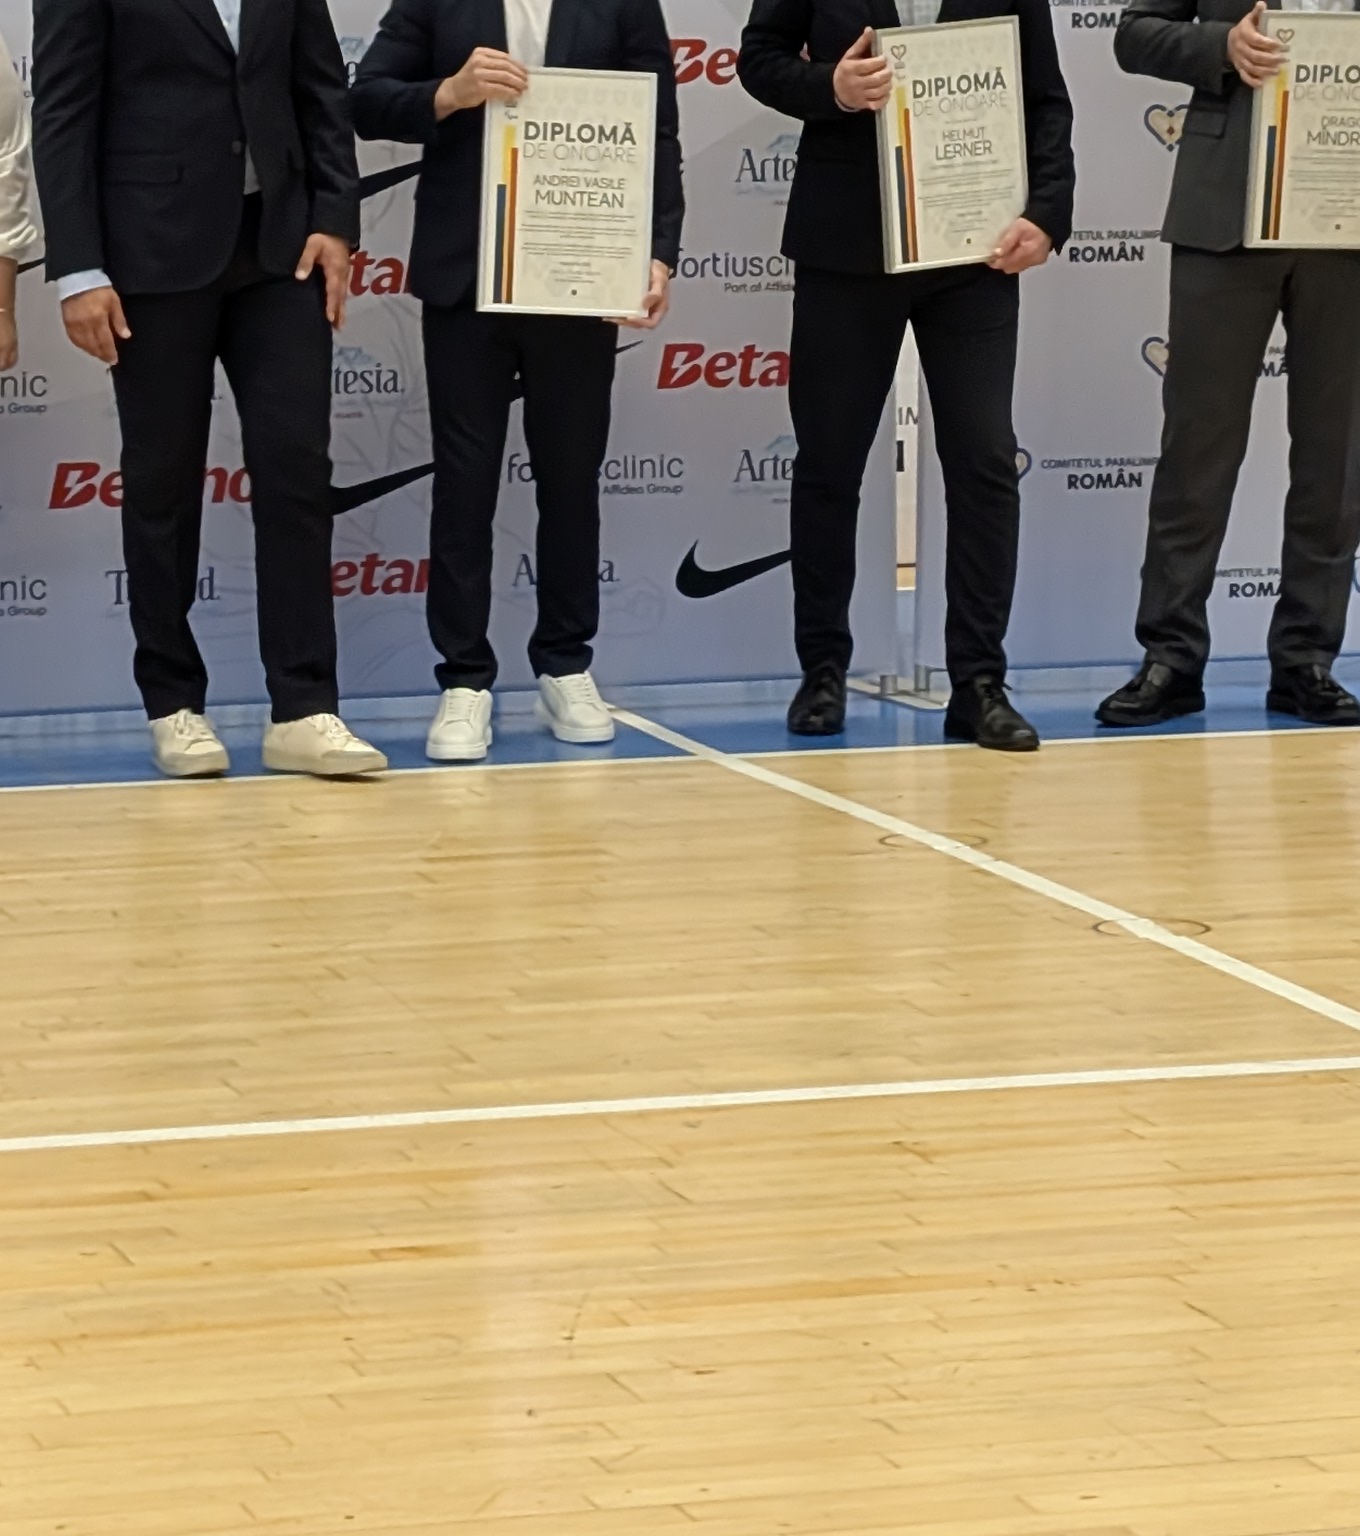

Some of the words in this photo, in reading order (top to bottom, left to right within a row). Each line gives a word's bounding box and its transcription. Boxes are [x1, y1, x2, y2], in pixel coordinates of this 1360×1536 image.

[1071, 13, 1118, 28] ROM
[912, 67, 1007, 99] DIPLOMĂ
[1293, 85, 1317, 101] DE
[913, 100, 933, 117] DE
[938, 91, 1008, 113] ONOARE
[524, 121, 636, 145] DIPLOMĂ
[942, 126, 986, 142] HELMUT
[523, 142, 547, 159] DE
[553, 144, 637, 163] ONOARE
[935, 140, 993, 161] LERNER
[735, 147, 796, 183] Arte
[584, 177, 626, 190] VASILE
[535, 190, 624, 208] MUNTEAN
[1069, 241, 1144, 263] ROMÂN
[657, 343, 790, 389] Beta
[734, 448, 793, 482] Arte
[48, 462, 251, 509] Beno
[1068, 469, 1142, 490] ROMÂN
